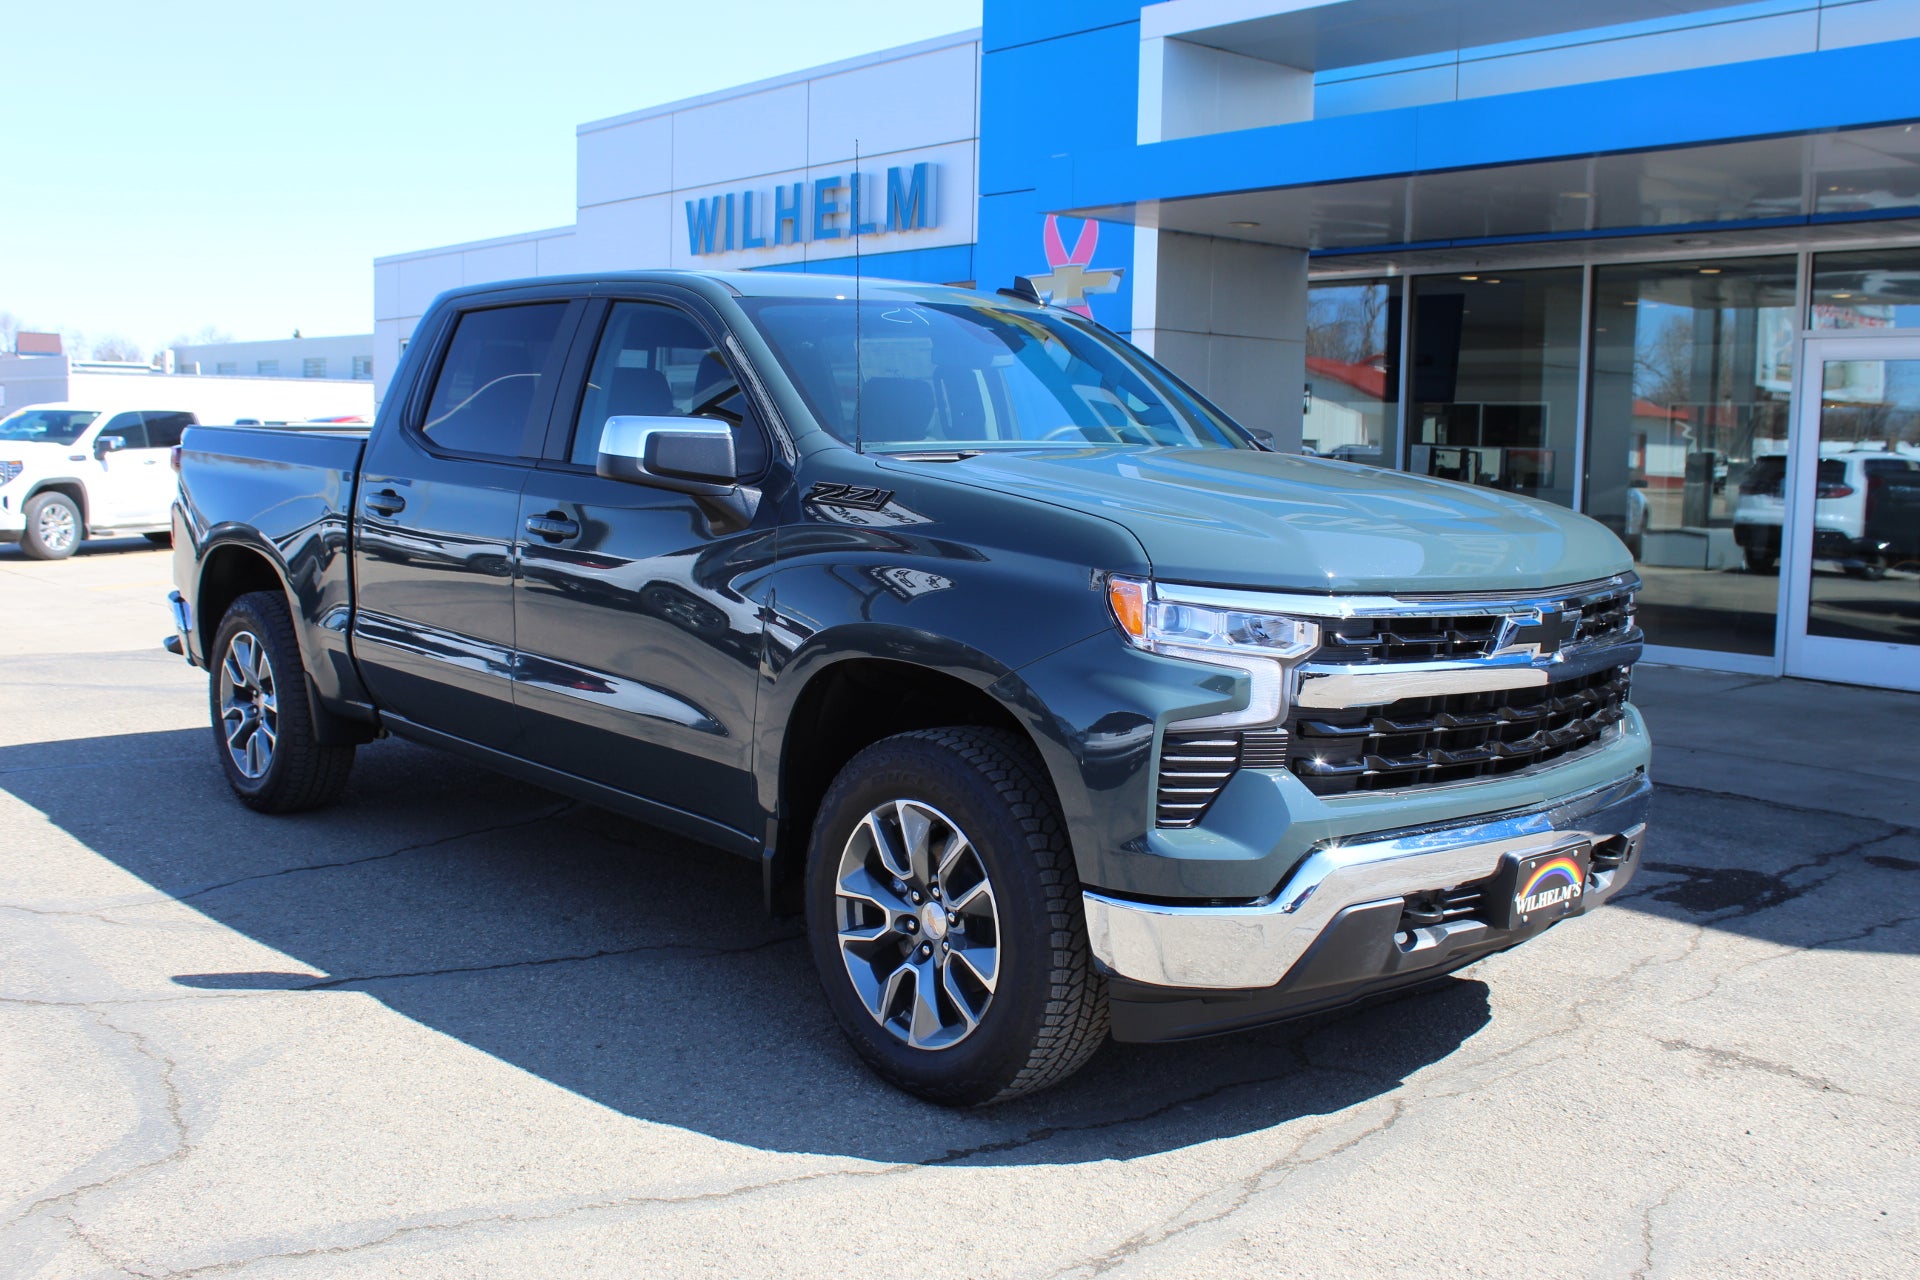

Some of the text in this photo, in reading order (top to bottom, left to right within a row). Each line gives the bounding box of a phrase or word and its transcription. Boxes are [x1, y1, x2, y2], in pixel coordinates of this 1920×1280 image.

[685, 162, 937, 256] WILHELM
[811, 481, 895, 511] Z71
[1514, 882, 1582, 915] WILHELM'S
